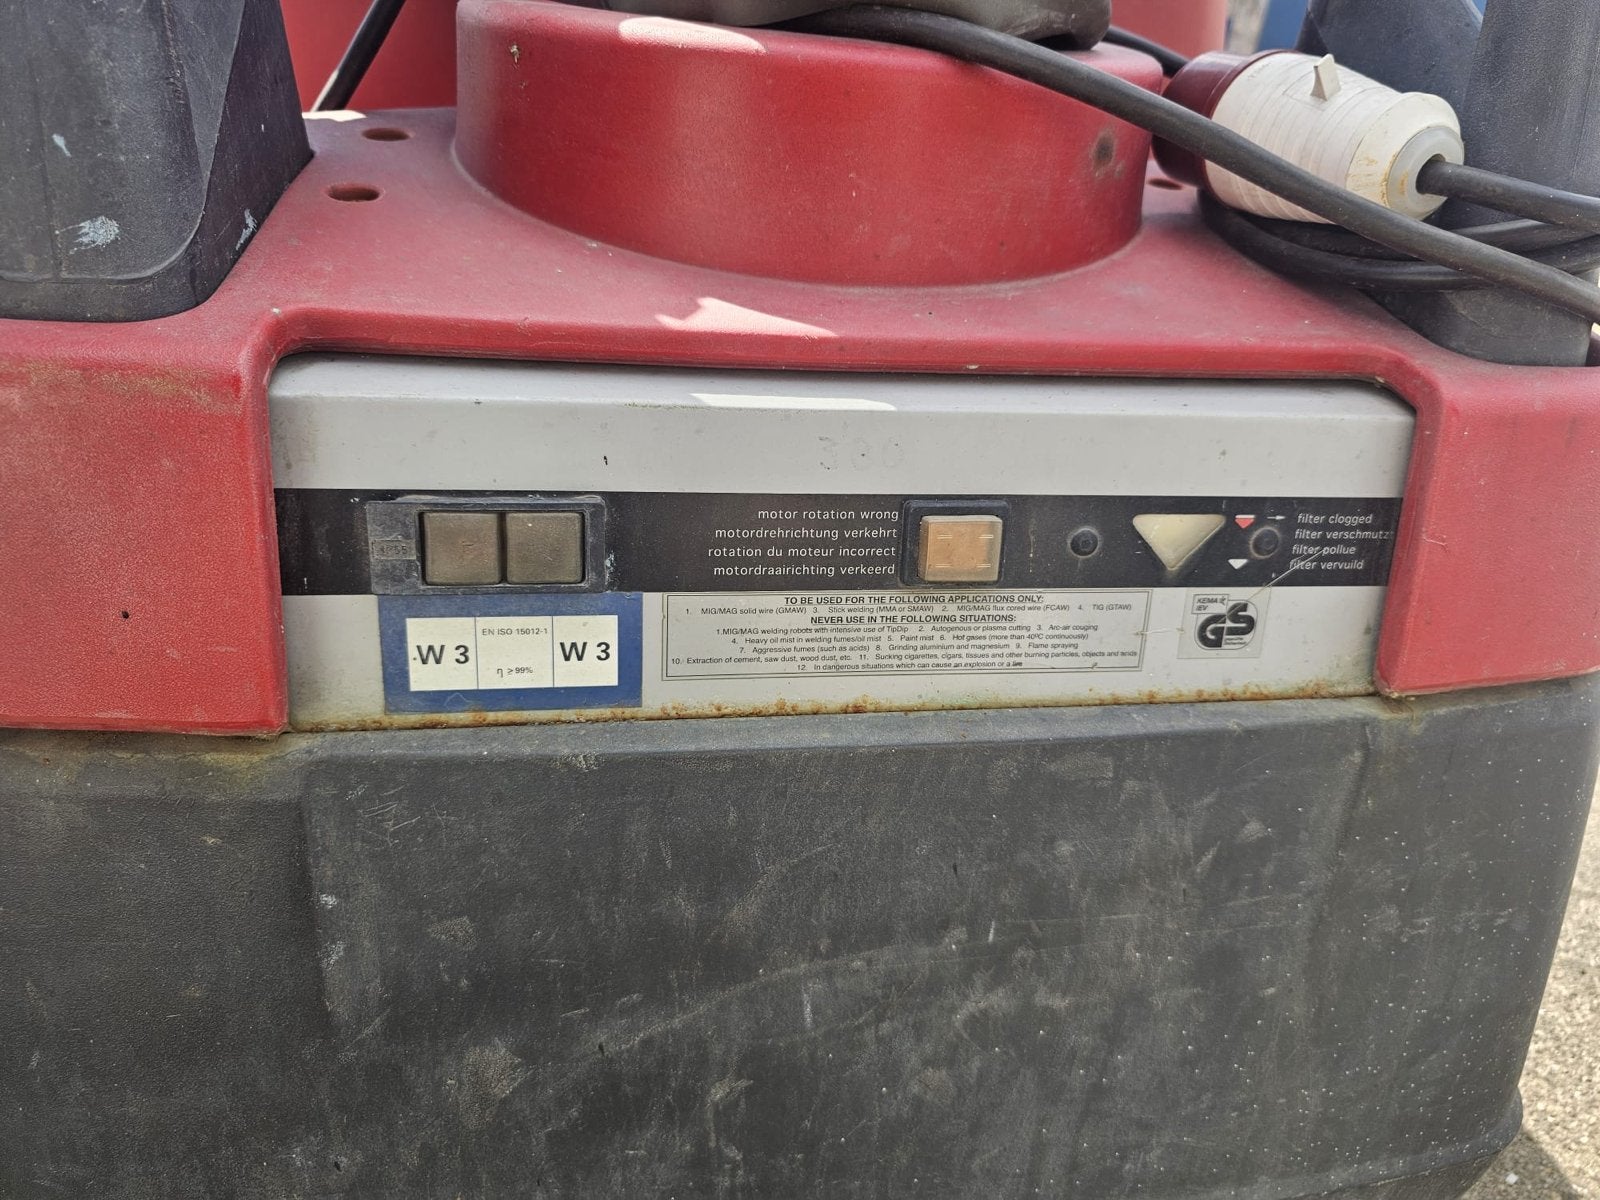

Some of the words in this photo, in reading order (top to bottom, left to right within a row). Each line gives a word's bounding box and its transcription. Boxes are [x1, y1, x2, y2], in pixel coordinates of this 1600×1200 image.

[758, 510, 798, 519] motor
[803, 510, 855, 519] rotation
[860, 510, 899, 521] wrong
[1298, 514, 1325, 524] filter
[1329, 514, 1373, 526] clogged
[715, 528, 839, 540] motordrehrichtung
[844, 528, 897, 538] verkehrt
[1295, 529, 1322, 539] filter
[708, 547, 762, 557] rotation
[767, 546, 783, 557] du
[788, 547, 834, 556] moteur
[839, 546, 896, 556] incorrect
[1292, 545, 1320, 555] filter
[1322, 545, 1356, 556] pollue
[714, 564, 835, 577] motordraairichting
[840, 564, 895, 575] verkeerd
[1290, 560, 1317, 570] filter
[1320, 560, 1364, 570] vervuild
[784, 597, 798, 605] TO
[816, 596, 842, 604] USED
[845, 596, 865, 604] FOR
[868, 596, 885, 604] THE
[948, 595, 1015, 603] APPLICATIONS
[1018, 595, 1044, 603] ONLY:
[775, 607, 807, 615] (GMAW)
[847, 606, 874, 614] welding
[876, 606, 896, 614] (MMA
[907, 605, 934, 613] SMAW)
[1043, 604, 1070, 612] (FCAW)
[1106, 604, 1132, 612] (GTAW)
[959, 614, 1016, 622] SITUATIONS:
[761, 627, 788, 636] welding
[931, 625, 971, 633] Autogenous
[982, 624, 1007, 632] plasma
[1008, 624, 1031, 632] cutting
[745, 637, 767, 645] Heavy
[805, 636, 831, 645] welding
[833, 635, 865, 643] fumes/oil
[988, 633, 1008, 641] (more
[1045, 633, 1089, 641] continuously)
[560, 642, 588, 661] W
[596, 642, 611, 661] 3
[752, 646, 791, 654] Aggressive
[793, 645, 815, 653] fumes
[889, 644, 918, 652] Grinding
[1050, 642, 1078, 650] spraying
[416, 645, 445, 665] W
[454, 645, 470, 664] 3
[875, 653, 902, 661] Sucking
[904, 653, 939, 661] cigarettes,
[1024, 651, 1049, 659] burning
[1082, 650, 1105, 658] objects
[822, 663, 860, 671] dangerous
[964, 661, 995, 669] explosion
